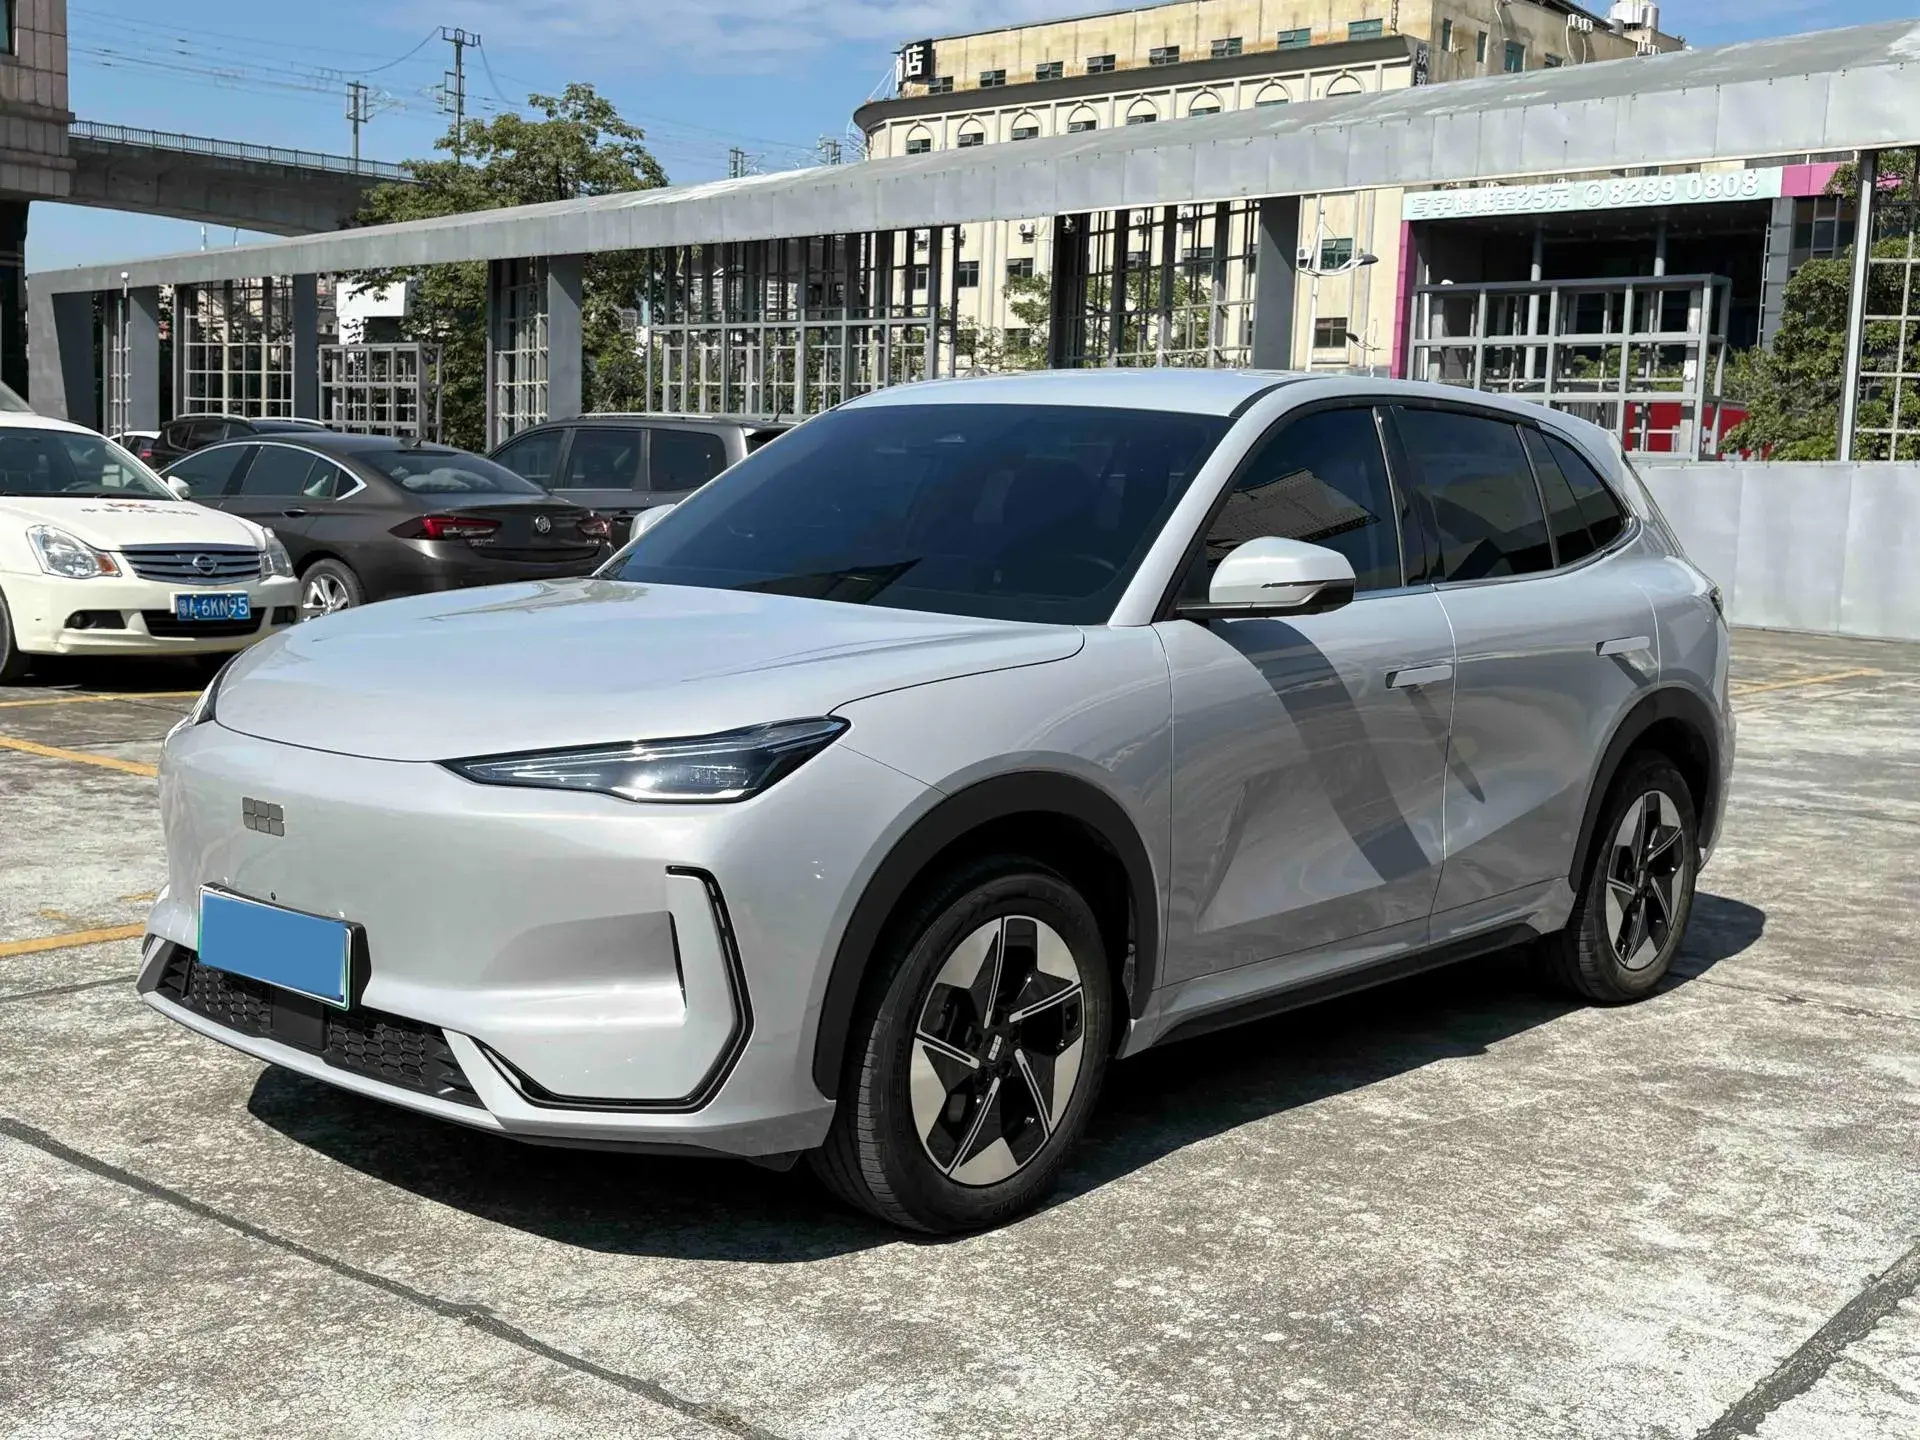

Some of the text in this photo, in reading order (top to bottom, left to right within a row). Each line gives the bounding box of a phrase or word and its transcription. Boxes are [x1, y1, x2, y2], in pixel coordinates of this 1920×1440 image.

[904, 44, 925, 78] 店
[1608, 176, 1677, 206] 8289
[1686, 168, 1761, 201] 0808
